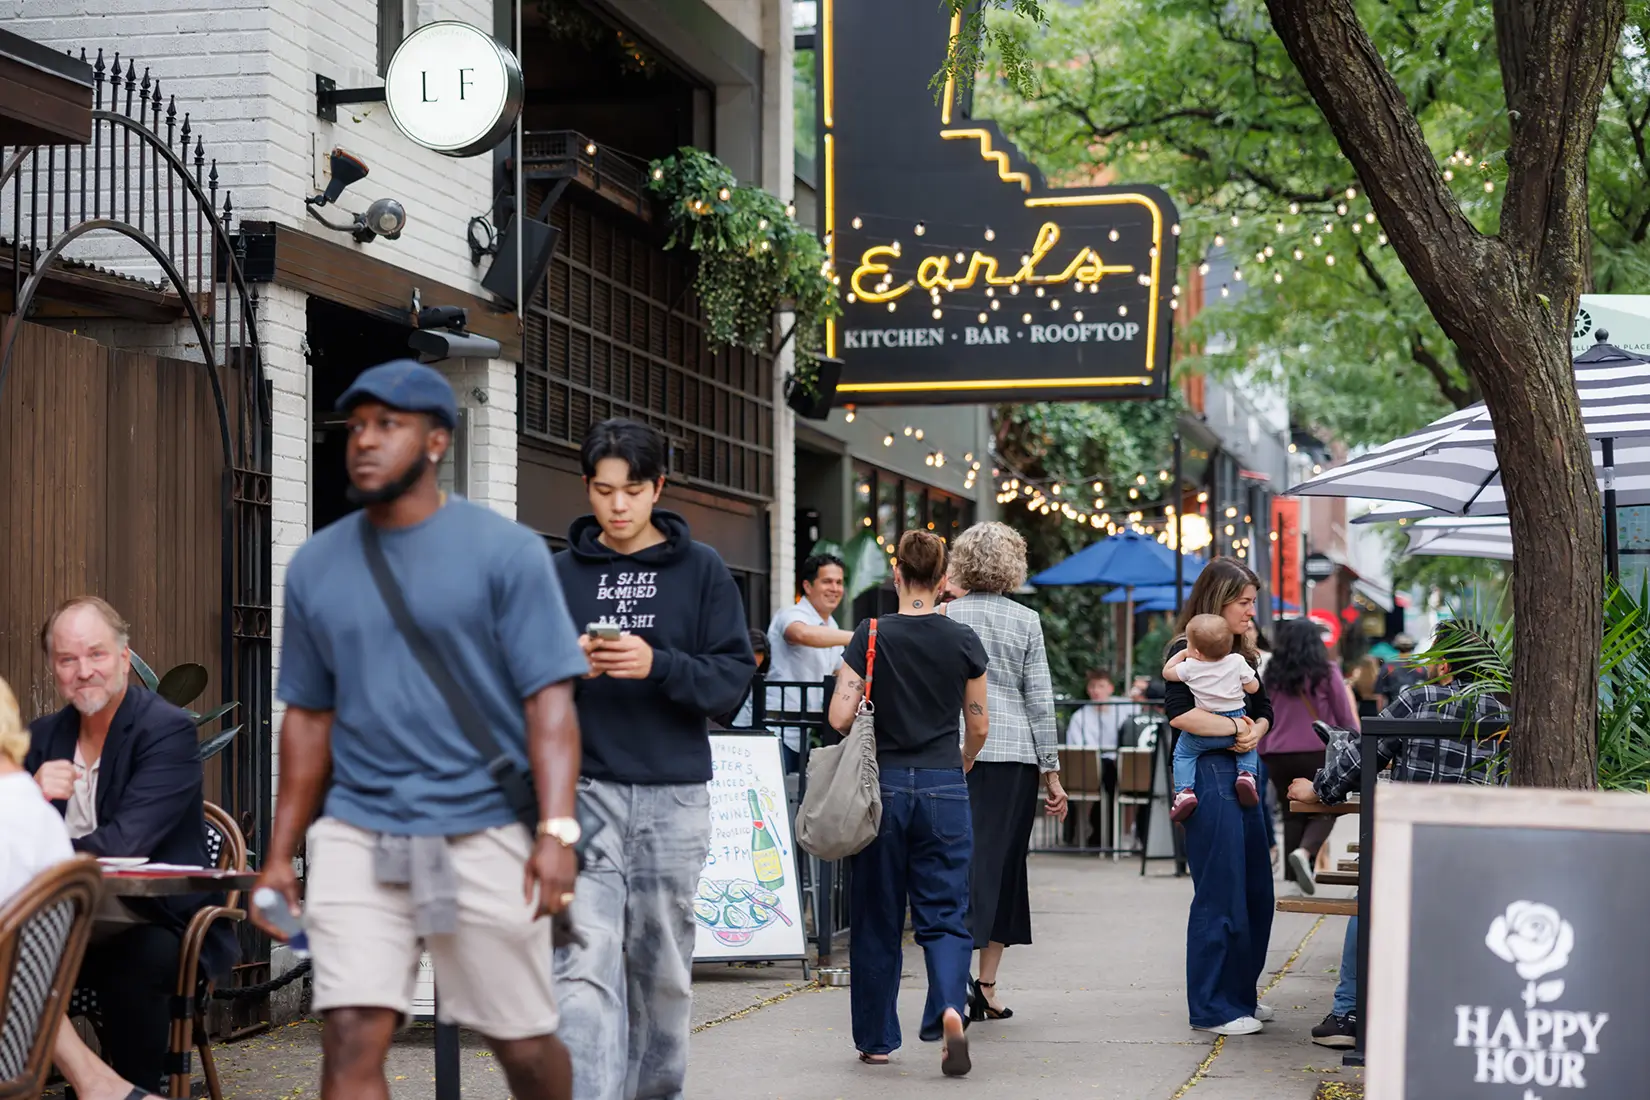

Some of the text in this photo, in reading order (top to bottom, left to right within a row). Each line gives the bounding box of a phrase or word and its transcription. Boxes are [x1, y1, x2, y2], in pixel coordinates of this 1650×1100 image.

[421, 68, 474, 103] L F
[851, 222, 1134, 303] Earls
[844, 322, 1140, 349] KITCHEN BAR ROOFTOP
[598, 574, 608, 586] I
[718, 807, 749, 820] WINE
[1454, 1005, 1609, 1054] HAPPY
[1474, 1049, 1587, 1088] HOUR
